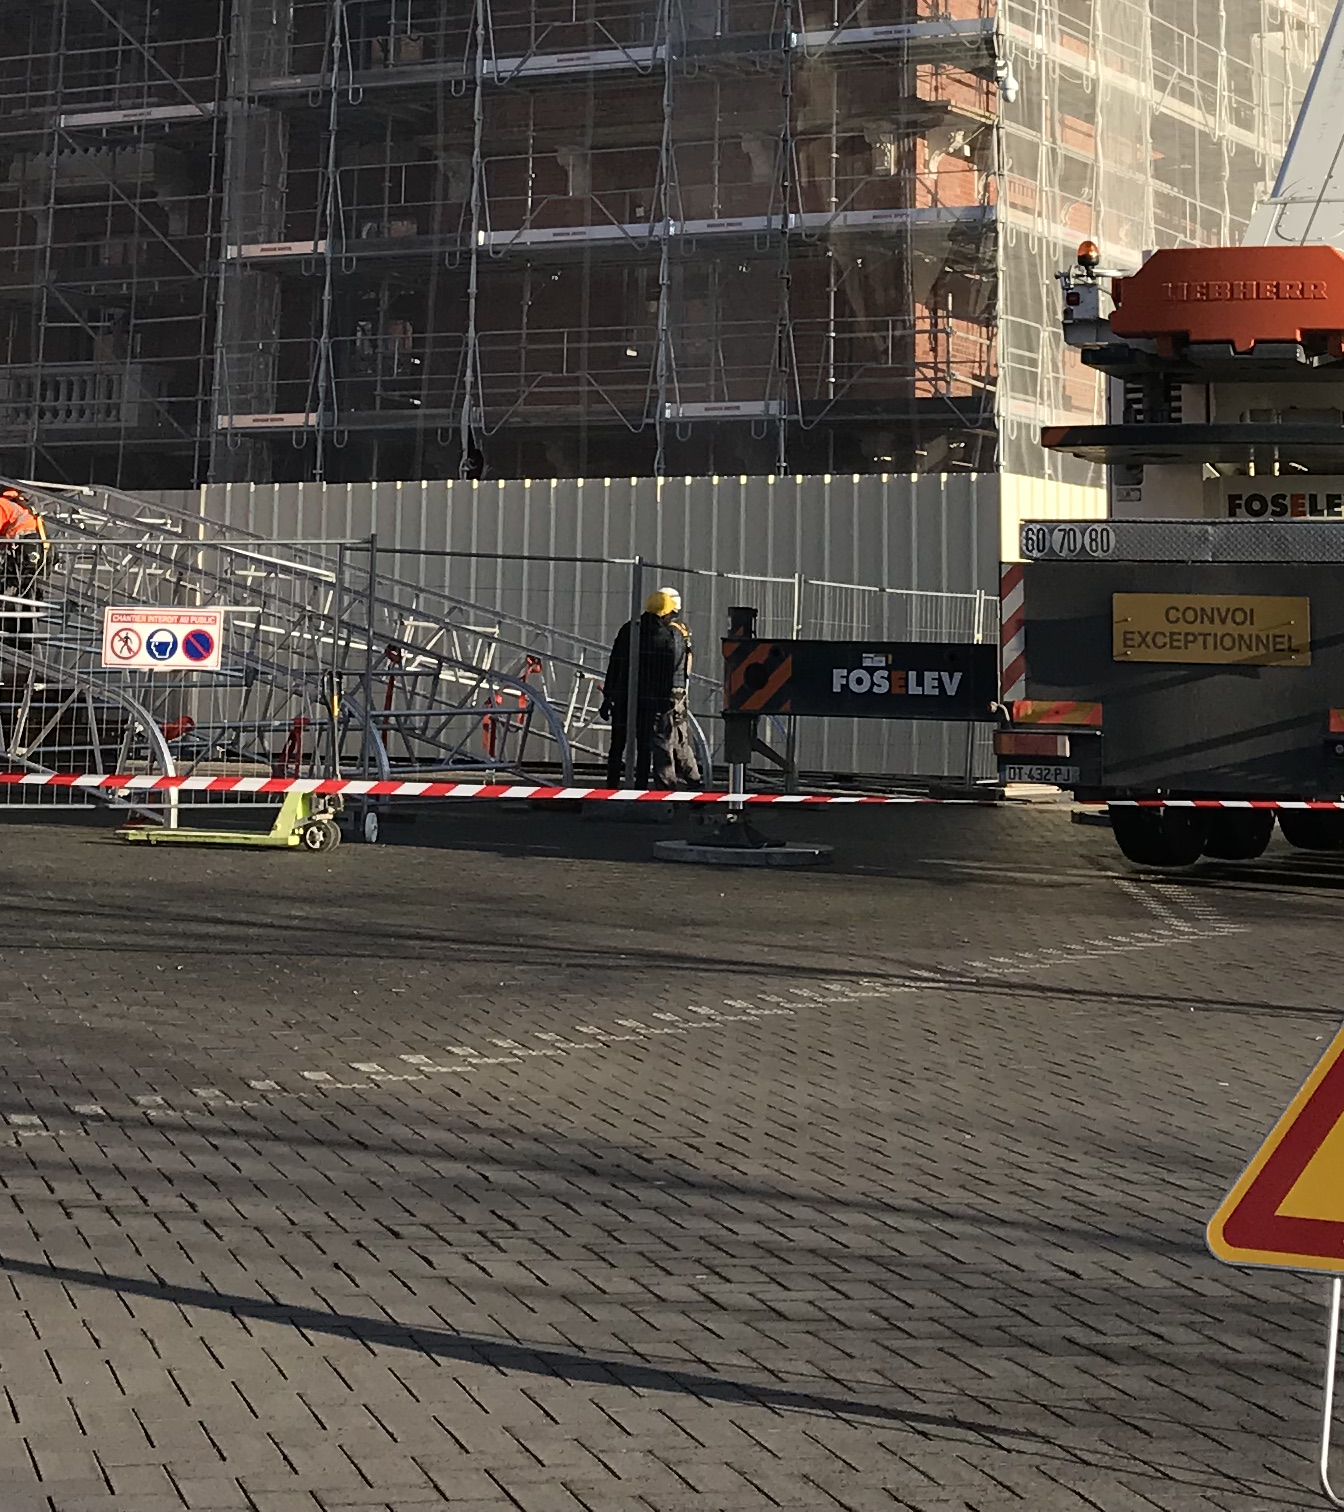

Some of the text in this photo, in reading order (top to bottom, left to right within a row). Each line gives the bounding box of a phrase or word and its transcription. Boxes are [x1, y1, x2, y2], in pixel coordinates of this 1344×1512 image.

[1161, 281, 1328, 301] LIEBHERR
[1025, 527, 1111, 554] 60 70 80
[112, 614, 216, 624] CHANTIER INTERDIT AU PUBLIC
[1164, 605, 1255, 626] CONVOI
[1122, 630, 1301, 654] EXCEPTIONNEL
[832, 668, 963, 696] FOSELEV
